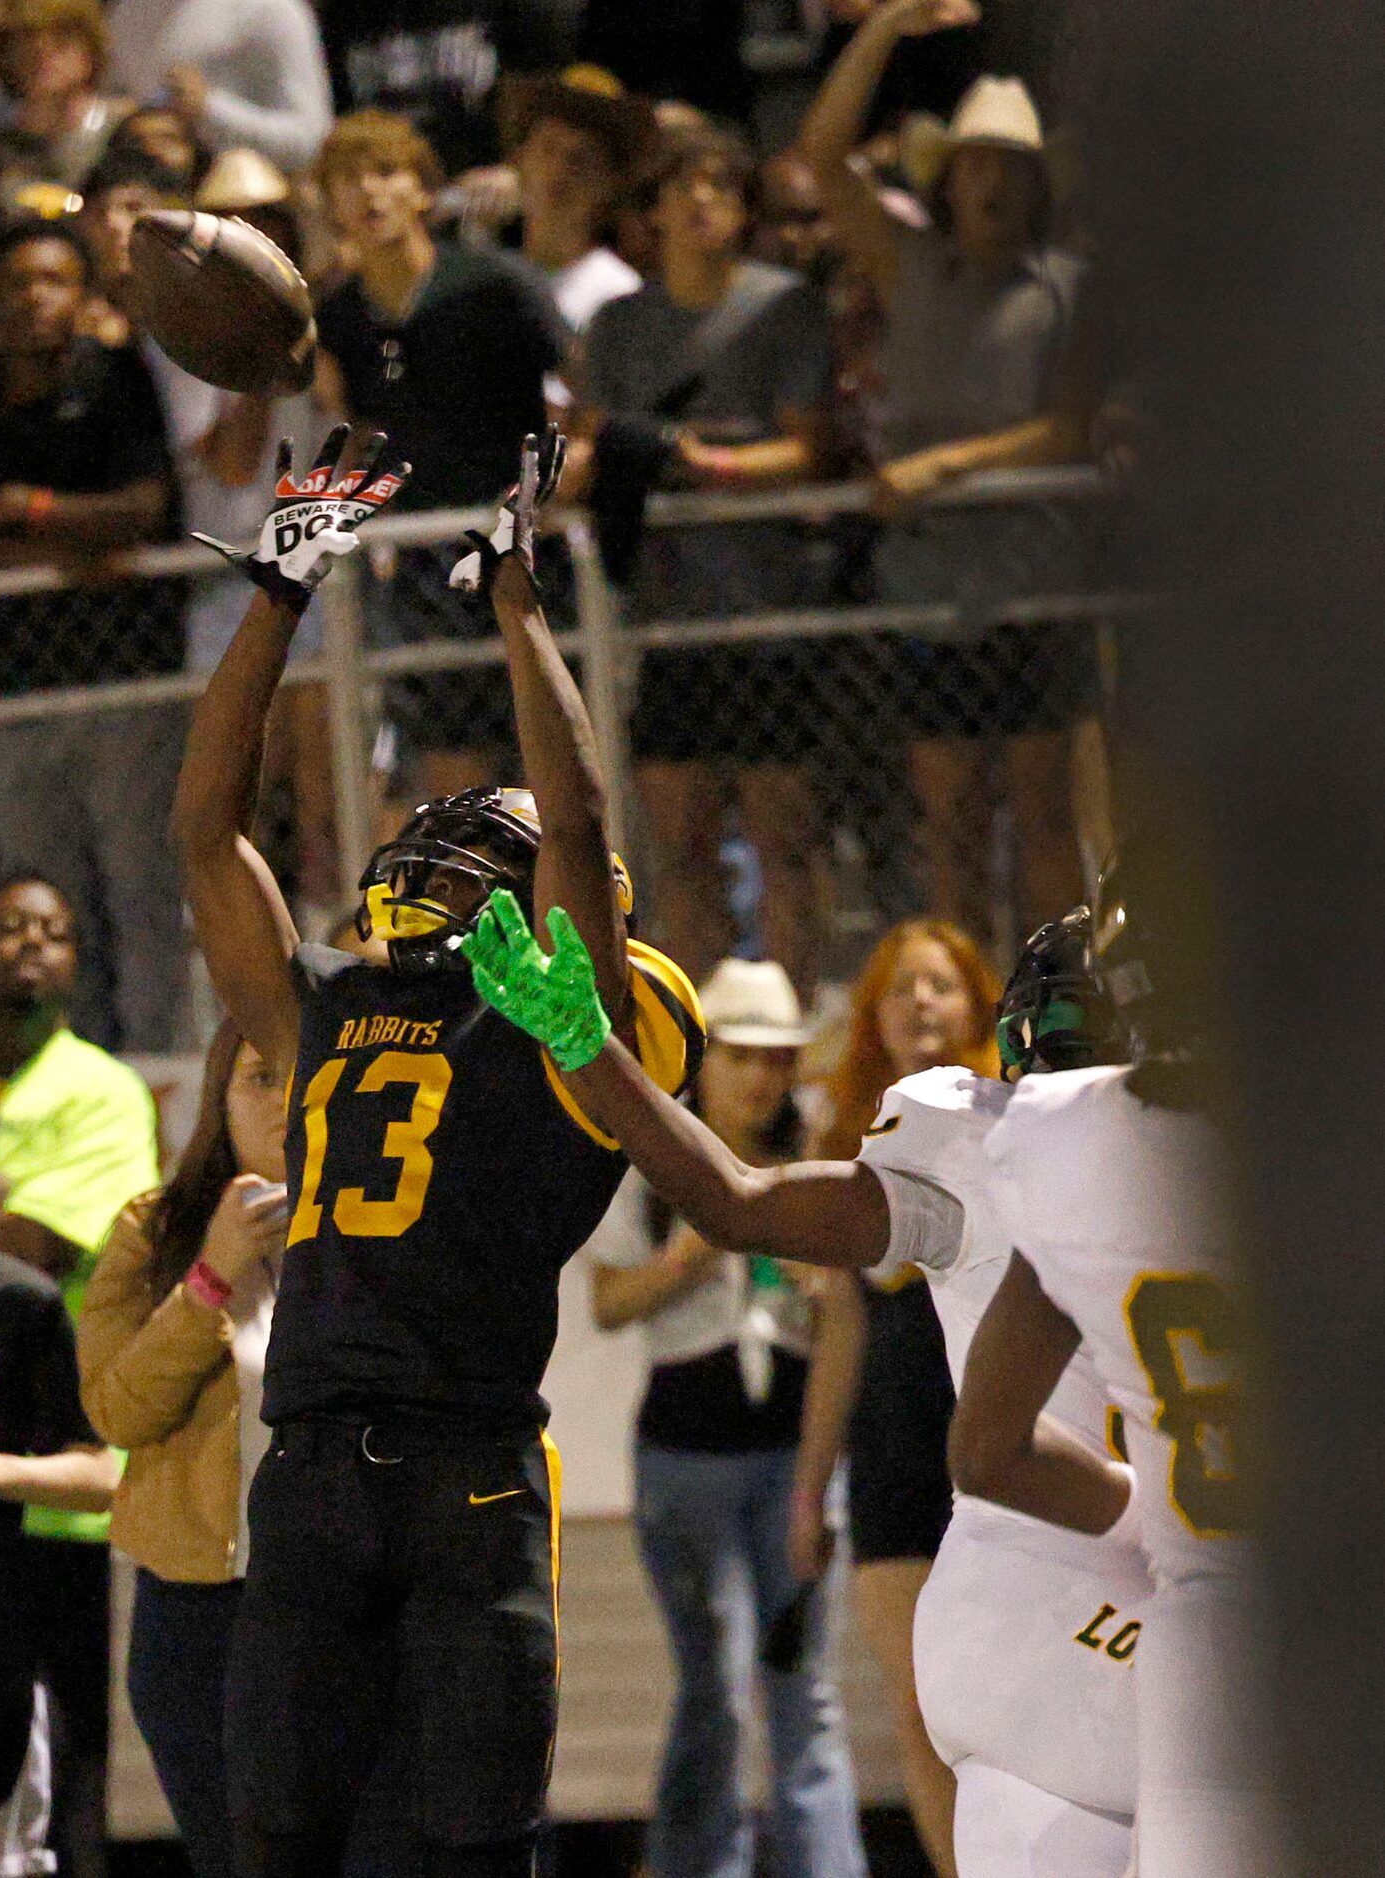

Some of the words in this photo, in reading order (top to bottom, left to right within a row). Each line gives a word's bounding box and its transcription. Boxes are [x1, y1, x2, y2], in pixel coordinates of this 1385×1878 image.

[274, 503, 350, 526] BEWARE
[275, 513, 355, 557] DO
[336, 1014, 443, 1050] RABBITS
[287, 1050, 454, 1249] 13
[1072, 1601, 1144, 1669] LO
